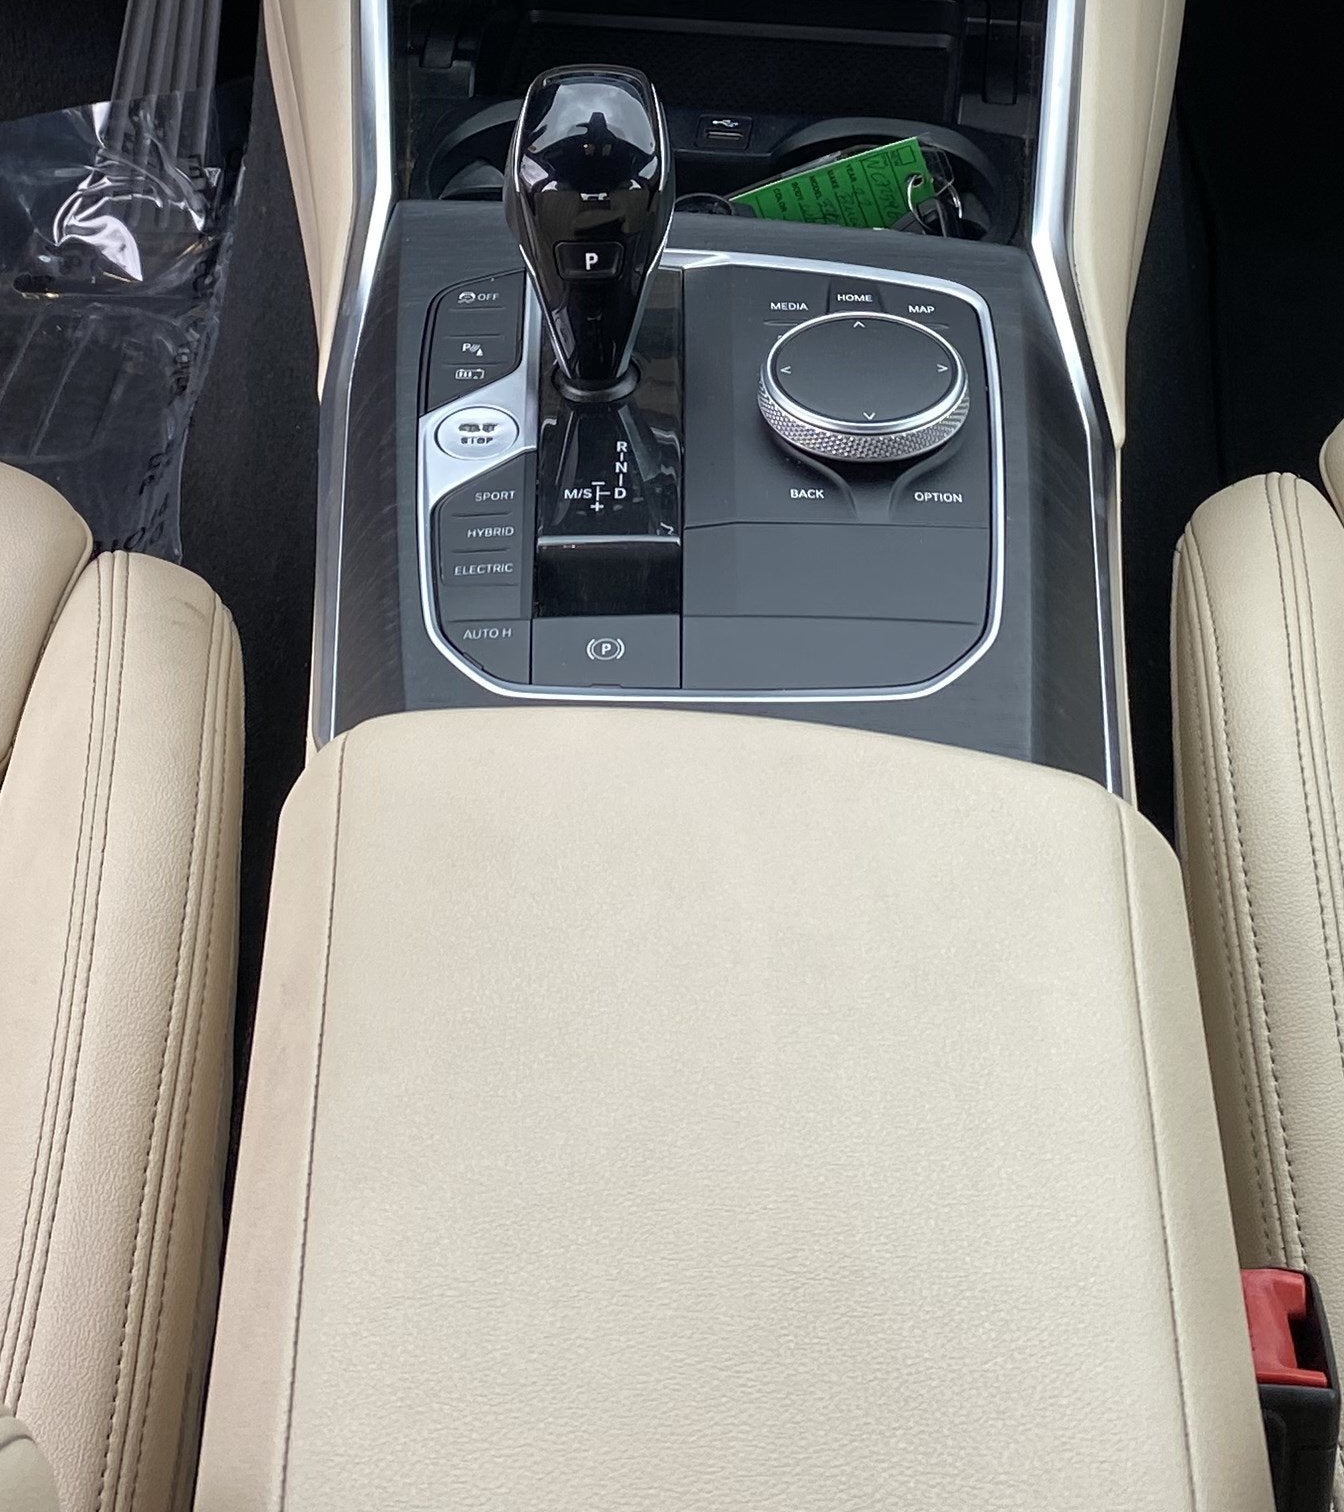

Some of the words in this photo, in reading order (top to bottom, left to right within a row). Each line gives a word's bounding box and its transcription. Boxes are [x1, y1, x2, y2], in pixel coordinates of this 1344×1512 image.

[809, 175, 822, 201] MODEL
[773, 187, 788, 214] COLOR
[585, 252, 599, 270] P
[477, 292, 499, 302] OFF
[837, 294, 872, 302] HOME
[770, 302, 808, 311] MEDIA
[908, 305, 935, 314] MAP
[616, 441, 627, 453] R
[616, 461, 627, 473] N
[475, 490, 516, 502] SPORT
[564, 488, 593, 500] M/S
[614, 488, 626, 499] D
[790, 489, 824, 499] BACK
[914, 491, 963, 503] OPTION
[466, 526, 515, 539] HYBRID
[454, 562, 514, 576] ELECTRIC
[463, 628, 499, 640] AUTO
[502, 628, 512, 639] H
[602, 644, 611, 654] P
